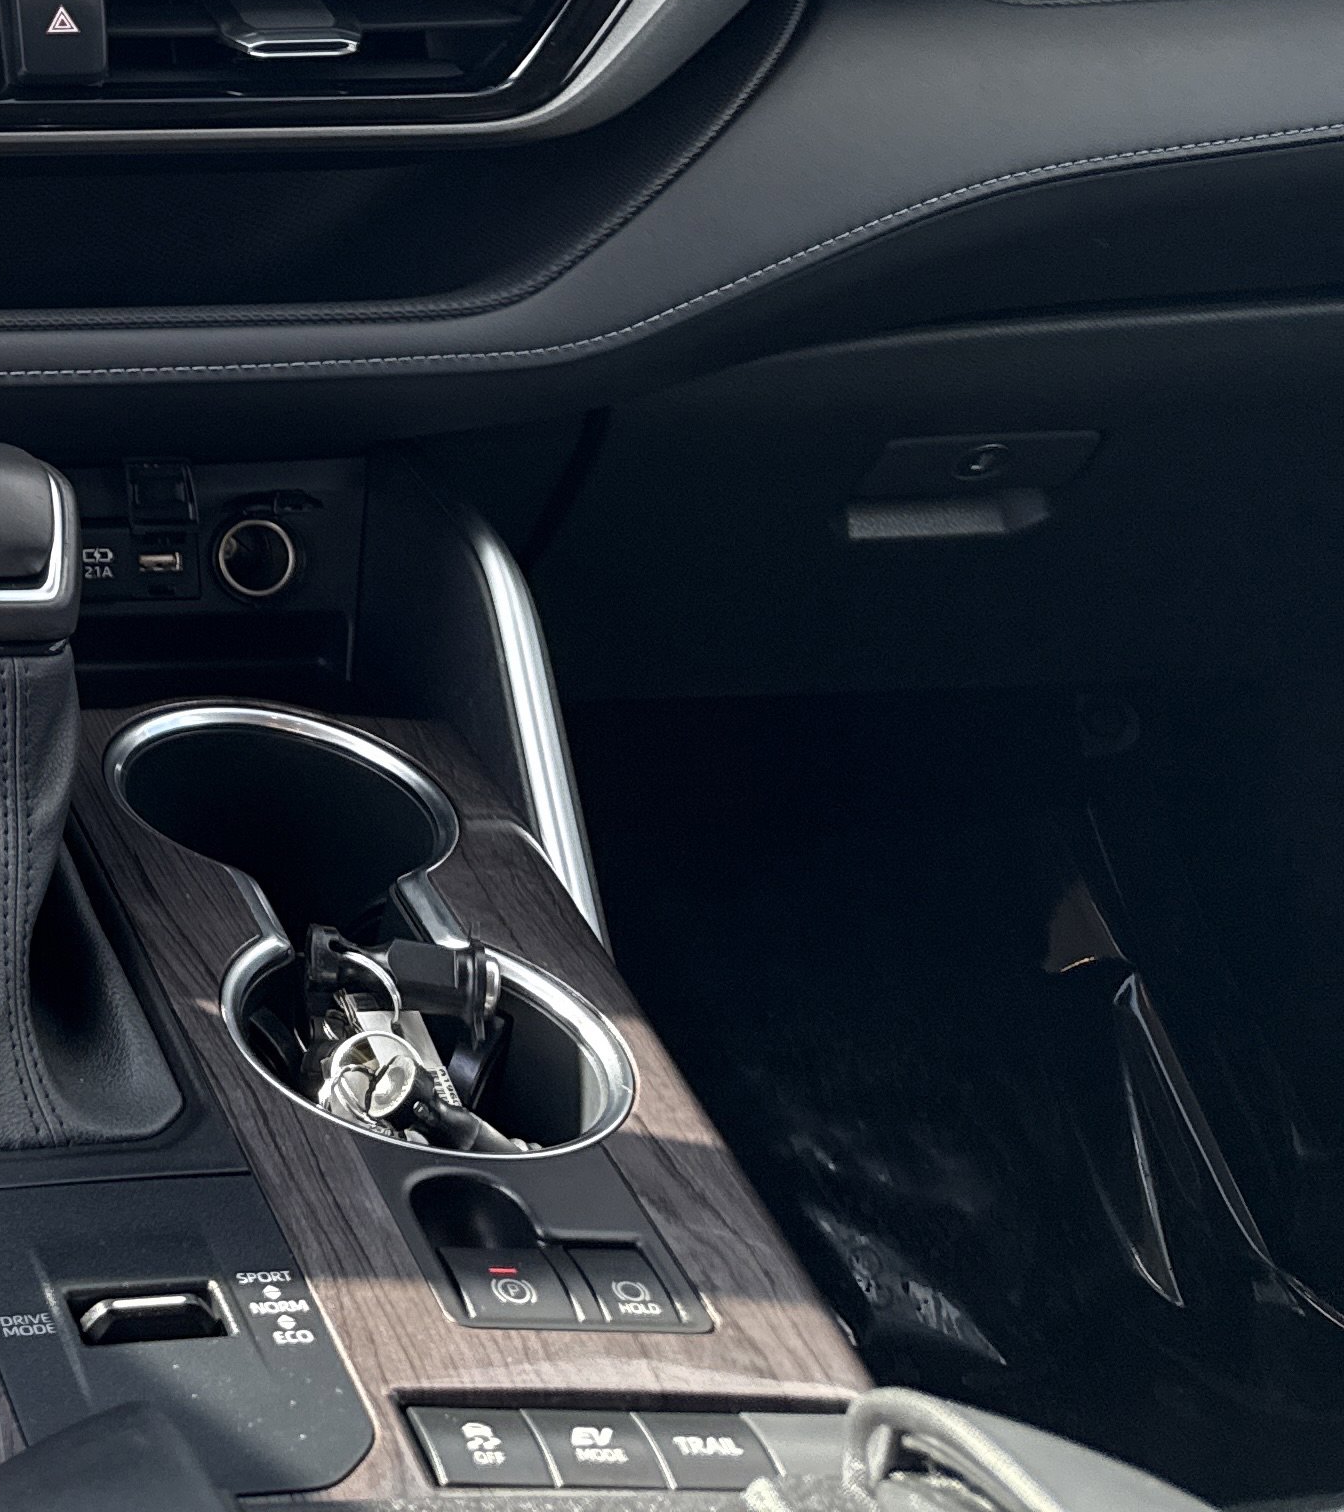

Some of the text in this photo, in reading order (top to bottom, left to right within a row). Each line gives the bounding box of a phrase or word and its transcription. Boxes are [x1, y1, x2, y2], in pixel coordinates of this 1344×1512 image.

[235, 1269, 292, 1285] SPORT
[249, 1298, 311, 1315] NORM
[618, 1301, 662, 1316] HOLD
[0, 1312, 54, 1326] DRIVE
[2, 1324, 57, 1338] MODE
[272, 1329, 315, 1345] ECO
[570, 1426, 614, 1448] EV
[672, 1436, 745, 1457] TRAIL
[473, 1450, 507, 1465] OFF
[575, 1447, 630, 1464] MODE
